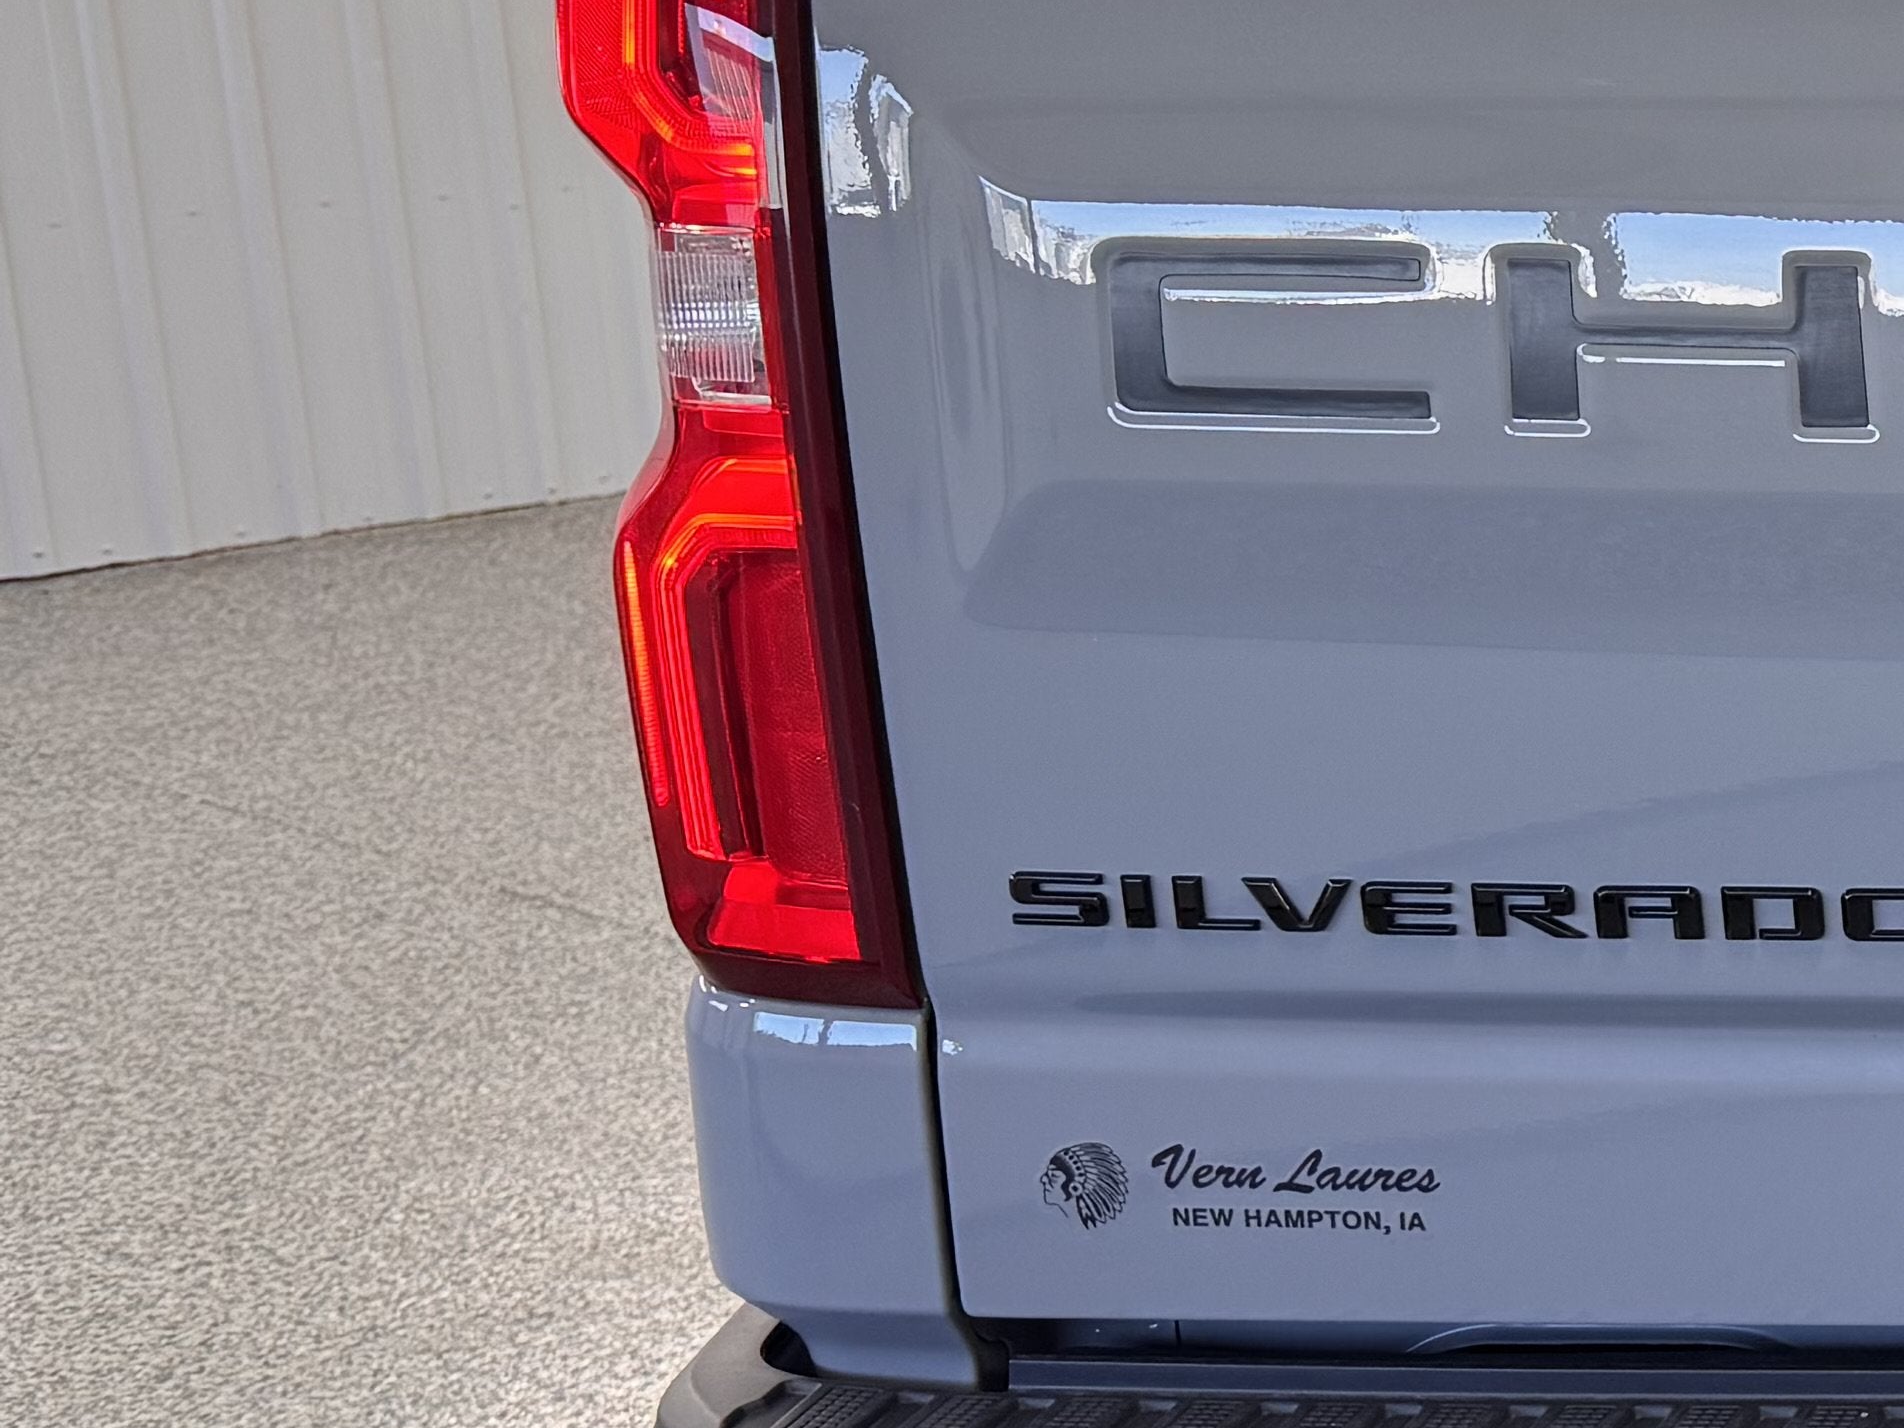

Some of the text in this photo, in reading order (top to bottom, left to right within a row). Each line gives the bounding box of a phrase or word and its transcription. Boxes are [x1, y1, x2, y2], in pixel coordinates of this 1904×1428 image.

[1151, 1143, 1441, 1194] Vern Laures
[1171, 1207, 1427, 1236] NEW HAMPTON, IA
